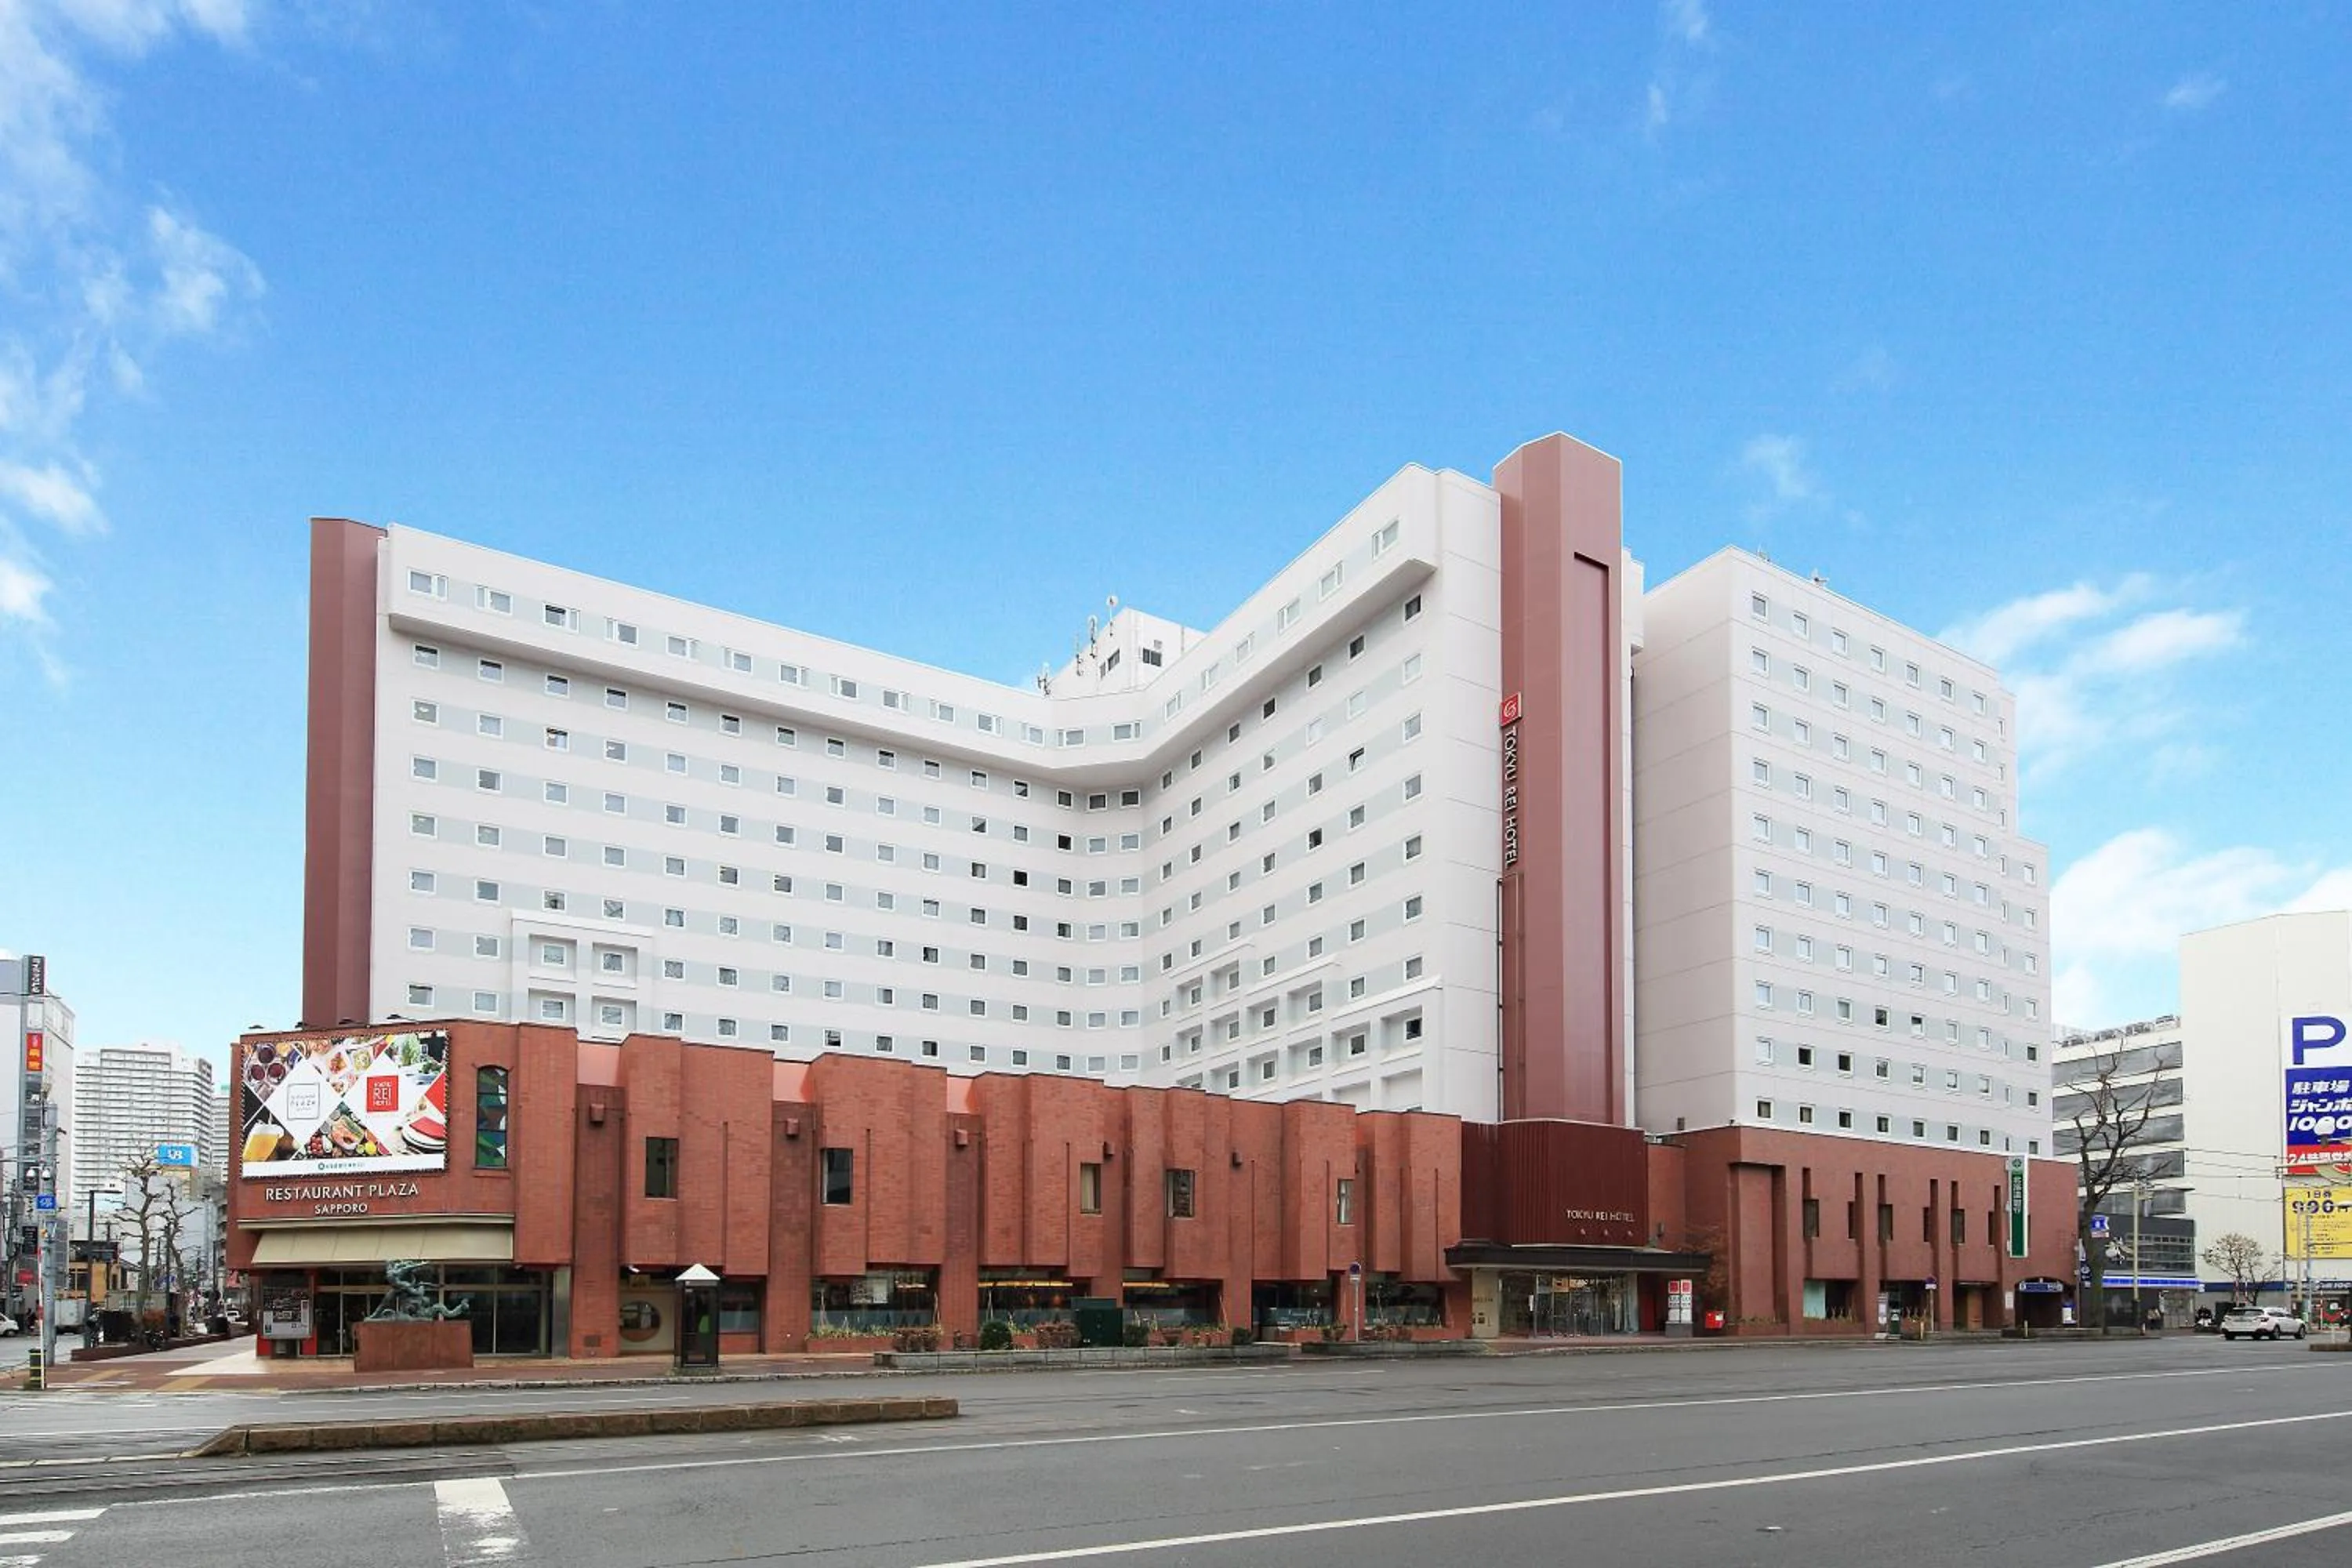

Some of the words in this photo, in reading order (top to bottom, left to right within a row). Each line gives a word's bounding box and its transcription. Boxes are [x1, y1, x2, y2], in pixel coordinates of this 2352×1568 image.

[1504, 726, 1517, 781] TOKYU
[1504, 786, 1517, 811] REI
[1504, 815, 1517, 868] HOTEL
[2292, 1015, 2347, 1065] P
[2292, 1080, 2350, 1094] 駐車場
[265, 1185, 364, 1201] RESTAURANT
[368, 1182, 419, 1197] PLAZA
[314, 1203, 368, 1214] SAPPORO
[1566, 1210, 1594, 1219] TOKYU
[1610, 1212, 1635, 1222] HOTEL
